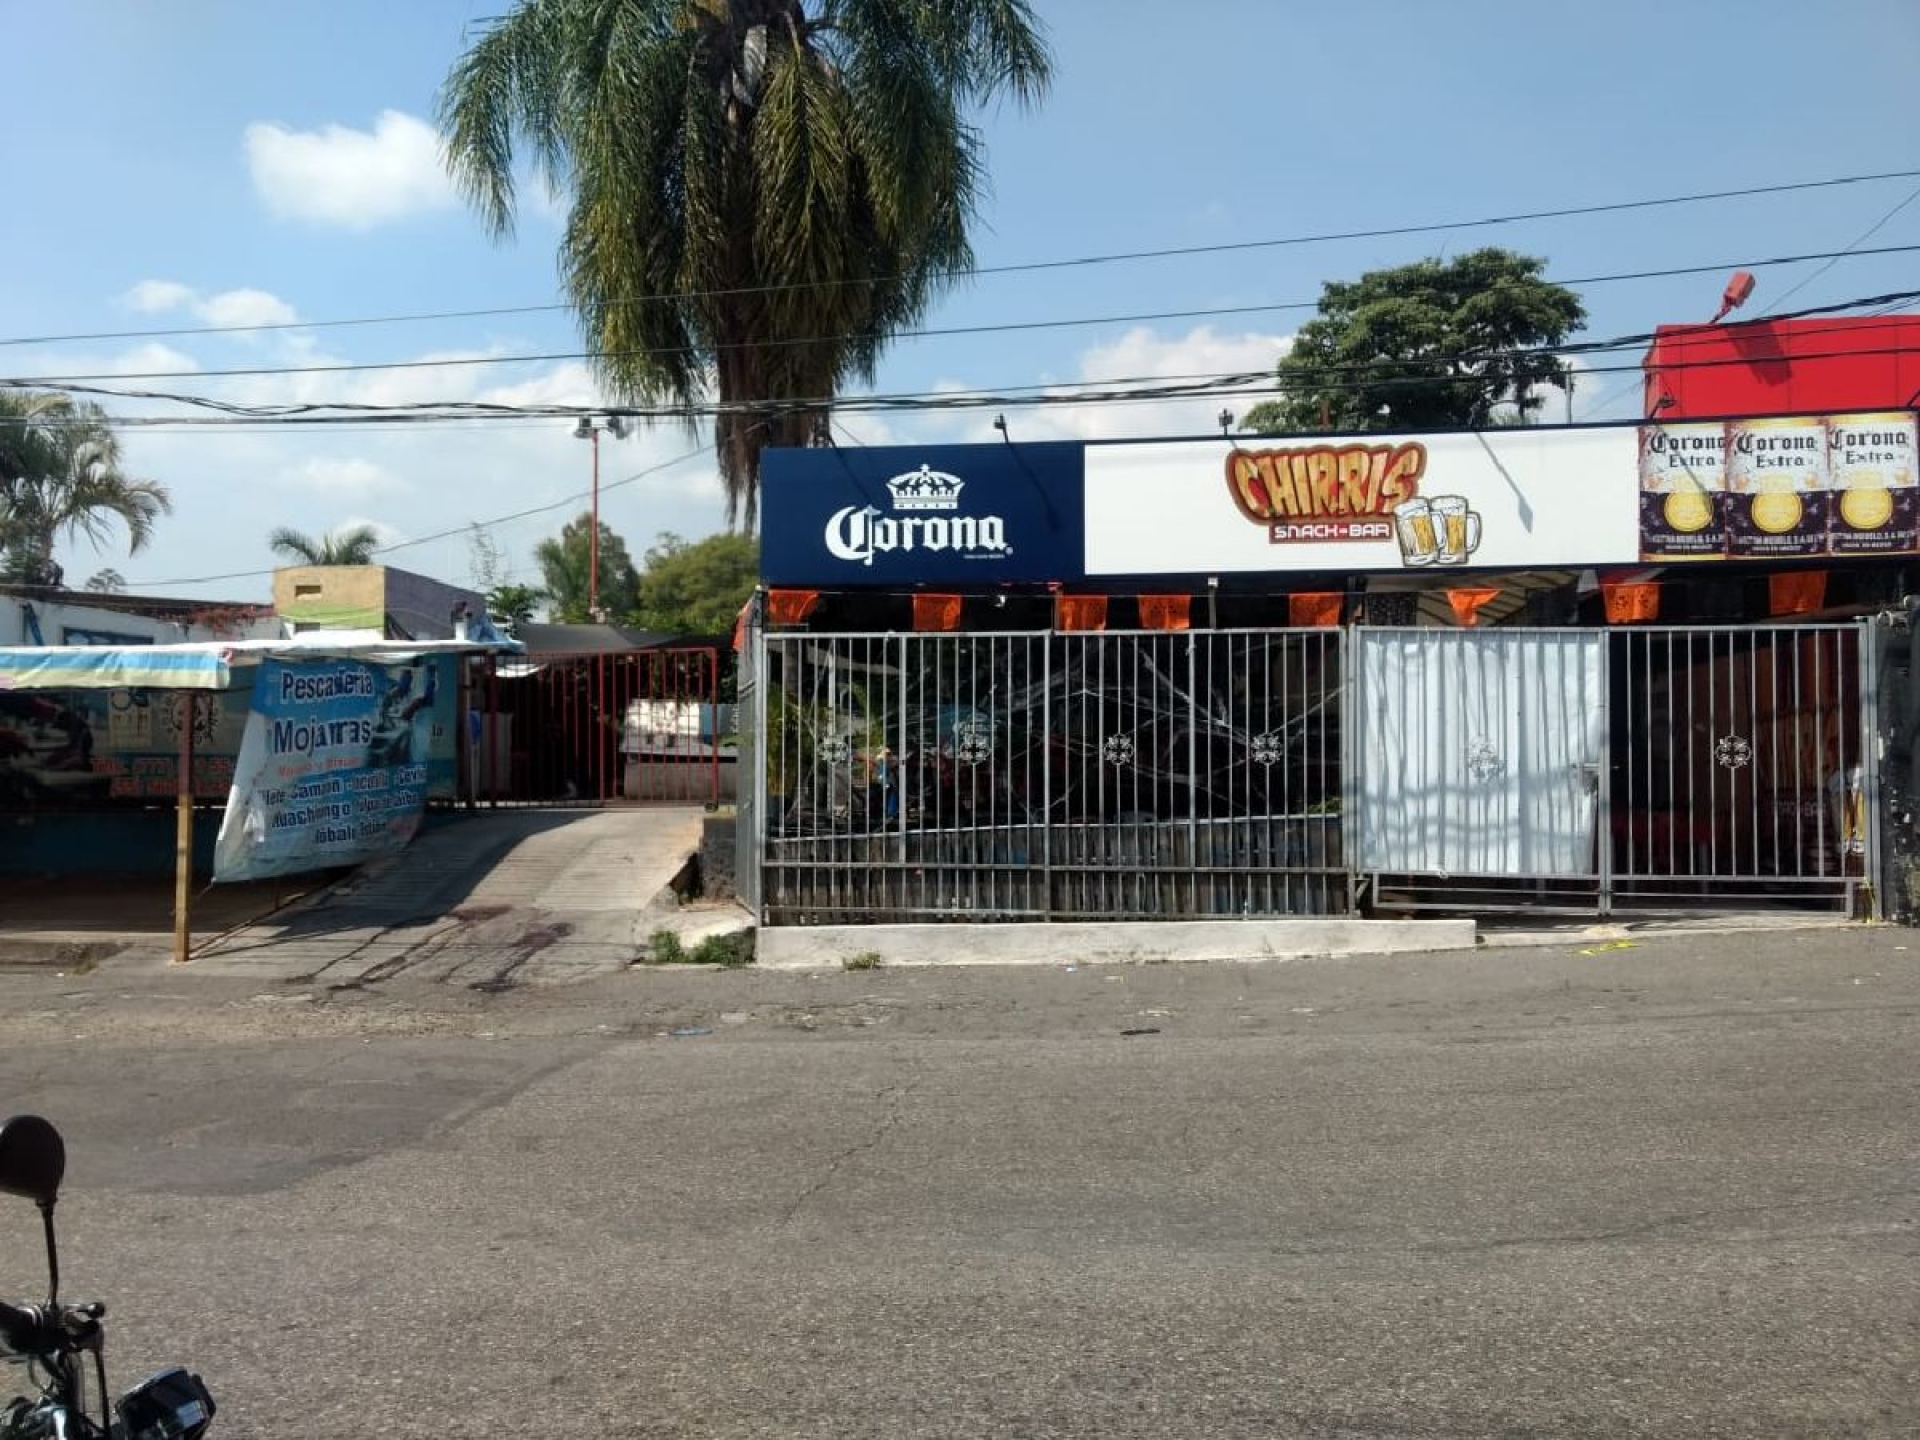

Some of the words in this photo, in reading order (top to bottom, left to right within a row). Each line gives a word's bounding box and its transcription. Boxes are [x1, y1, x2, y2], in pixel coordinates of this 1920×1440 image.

[1736, 432, 1816, 454] Corona
[1668, 454, 1716, 468] Extra
[1755, 454, 1804, 469] Extra
[1845, 450, 1894, 465] Extra
[1230, 446, 1423, 520] CHIRRIS
[824, 504, 1008, 566] Corona
[1273, 522, 1391, 539] SNACK-BAR
